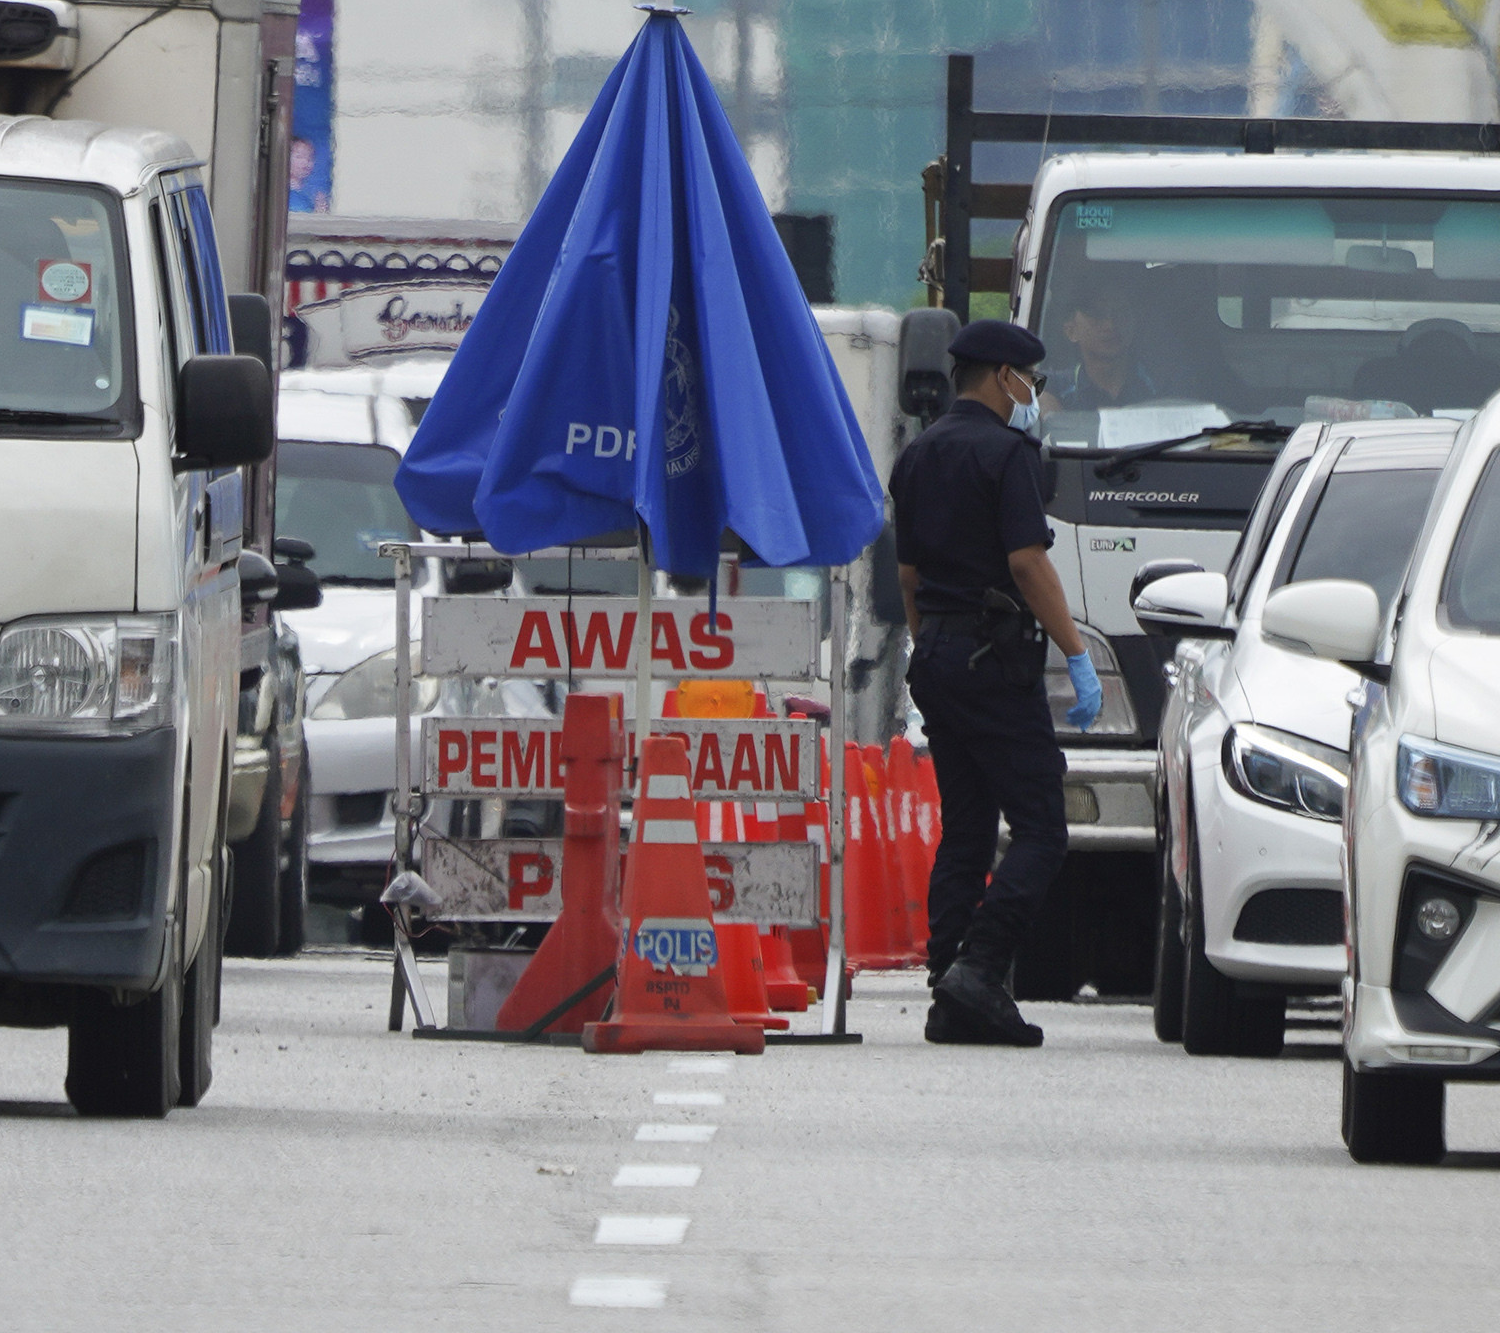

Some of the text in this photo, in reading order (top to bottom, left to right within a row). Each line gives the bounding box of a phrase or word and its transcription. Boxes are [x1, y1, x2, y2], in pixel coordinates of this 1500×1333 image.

[1088, 491, 1199, 503] INTERCOOLER
[509, 611, 735, 671] AWAS
[637, 932, 714, 962] POLIS
